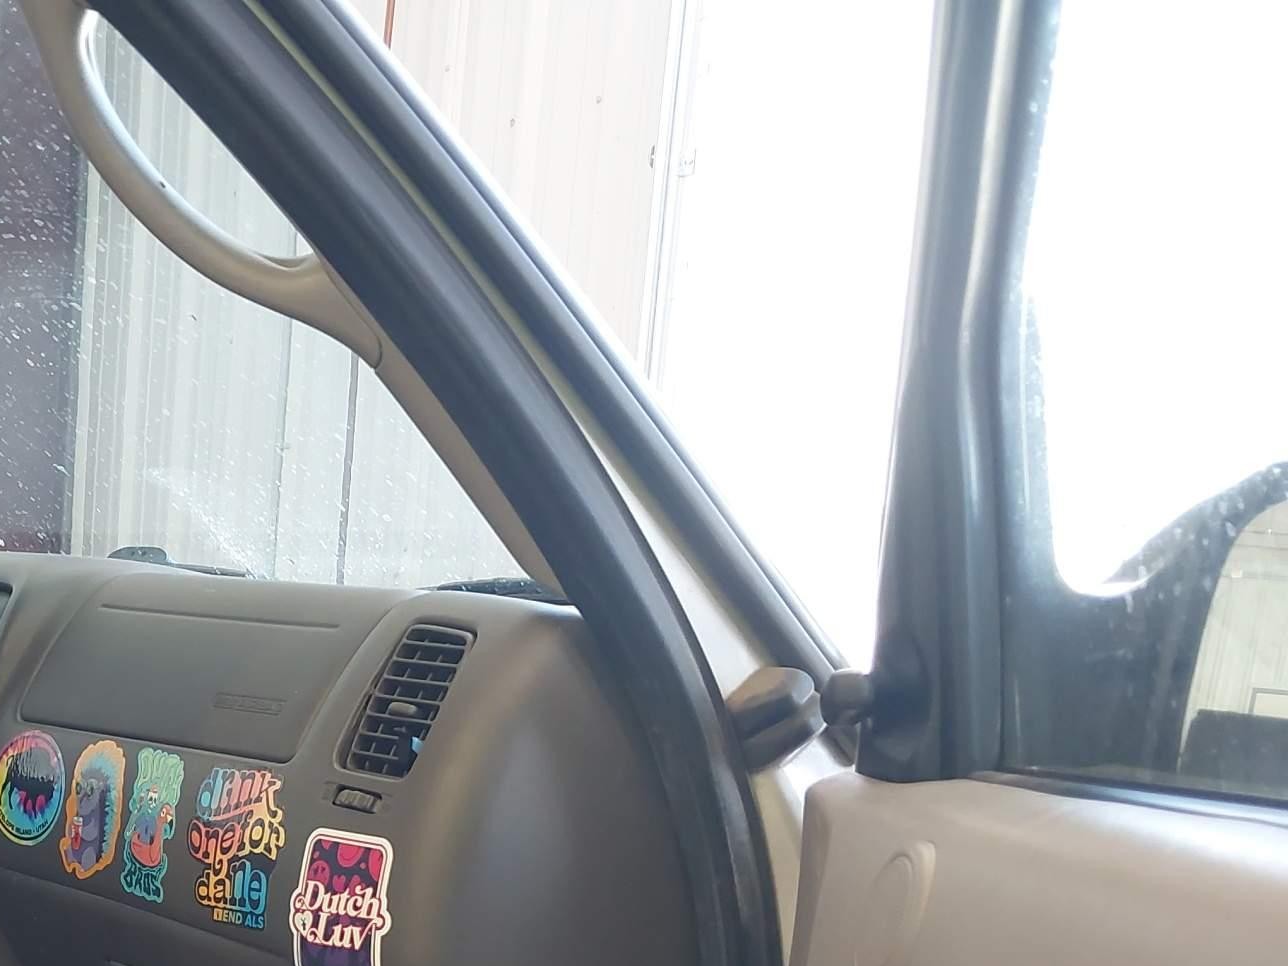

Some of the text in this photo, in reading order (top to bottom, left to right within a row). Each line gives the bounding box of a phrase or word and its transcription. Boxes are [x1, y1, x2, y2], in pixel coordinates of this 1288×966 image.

[188, 809, 286, 864] one for
[295, 880, 382, 921] Dutch
[244, 914, 264, 928] ALS
[307, 912, 375, 950] Luv
